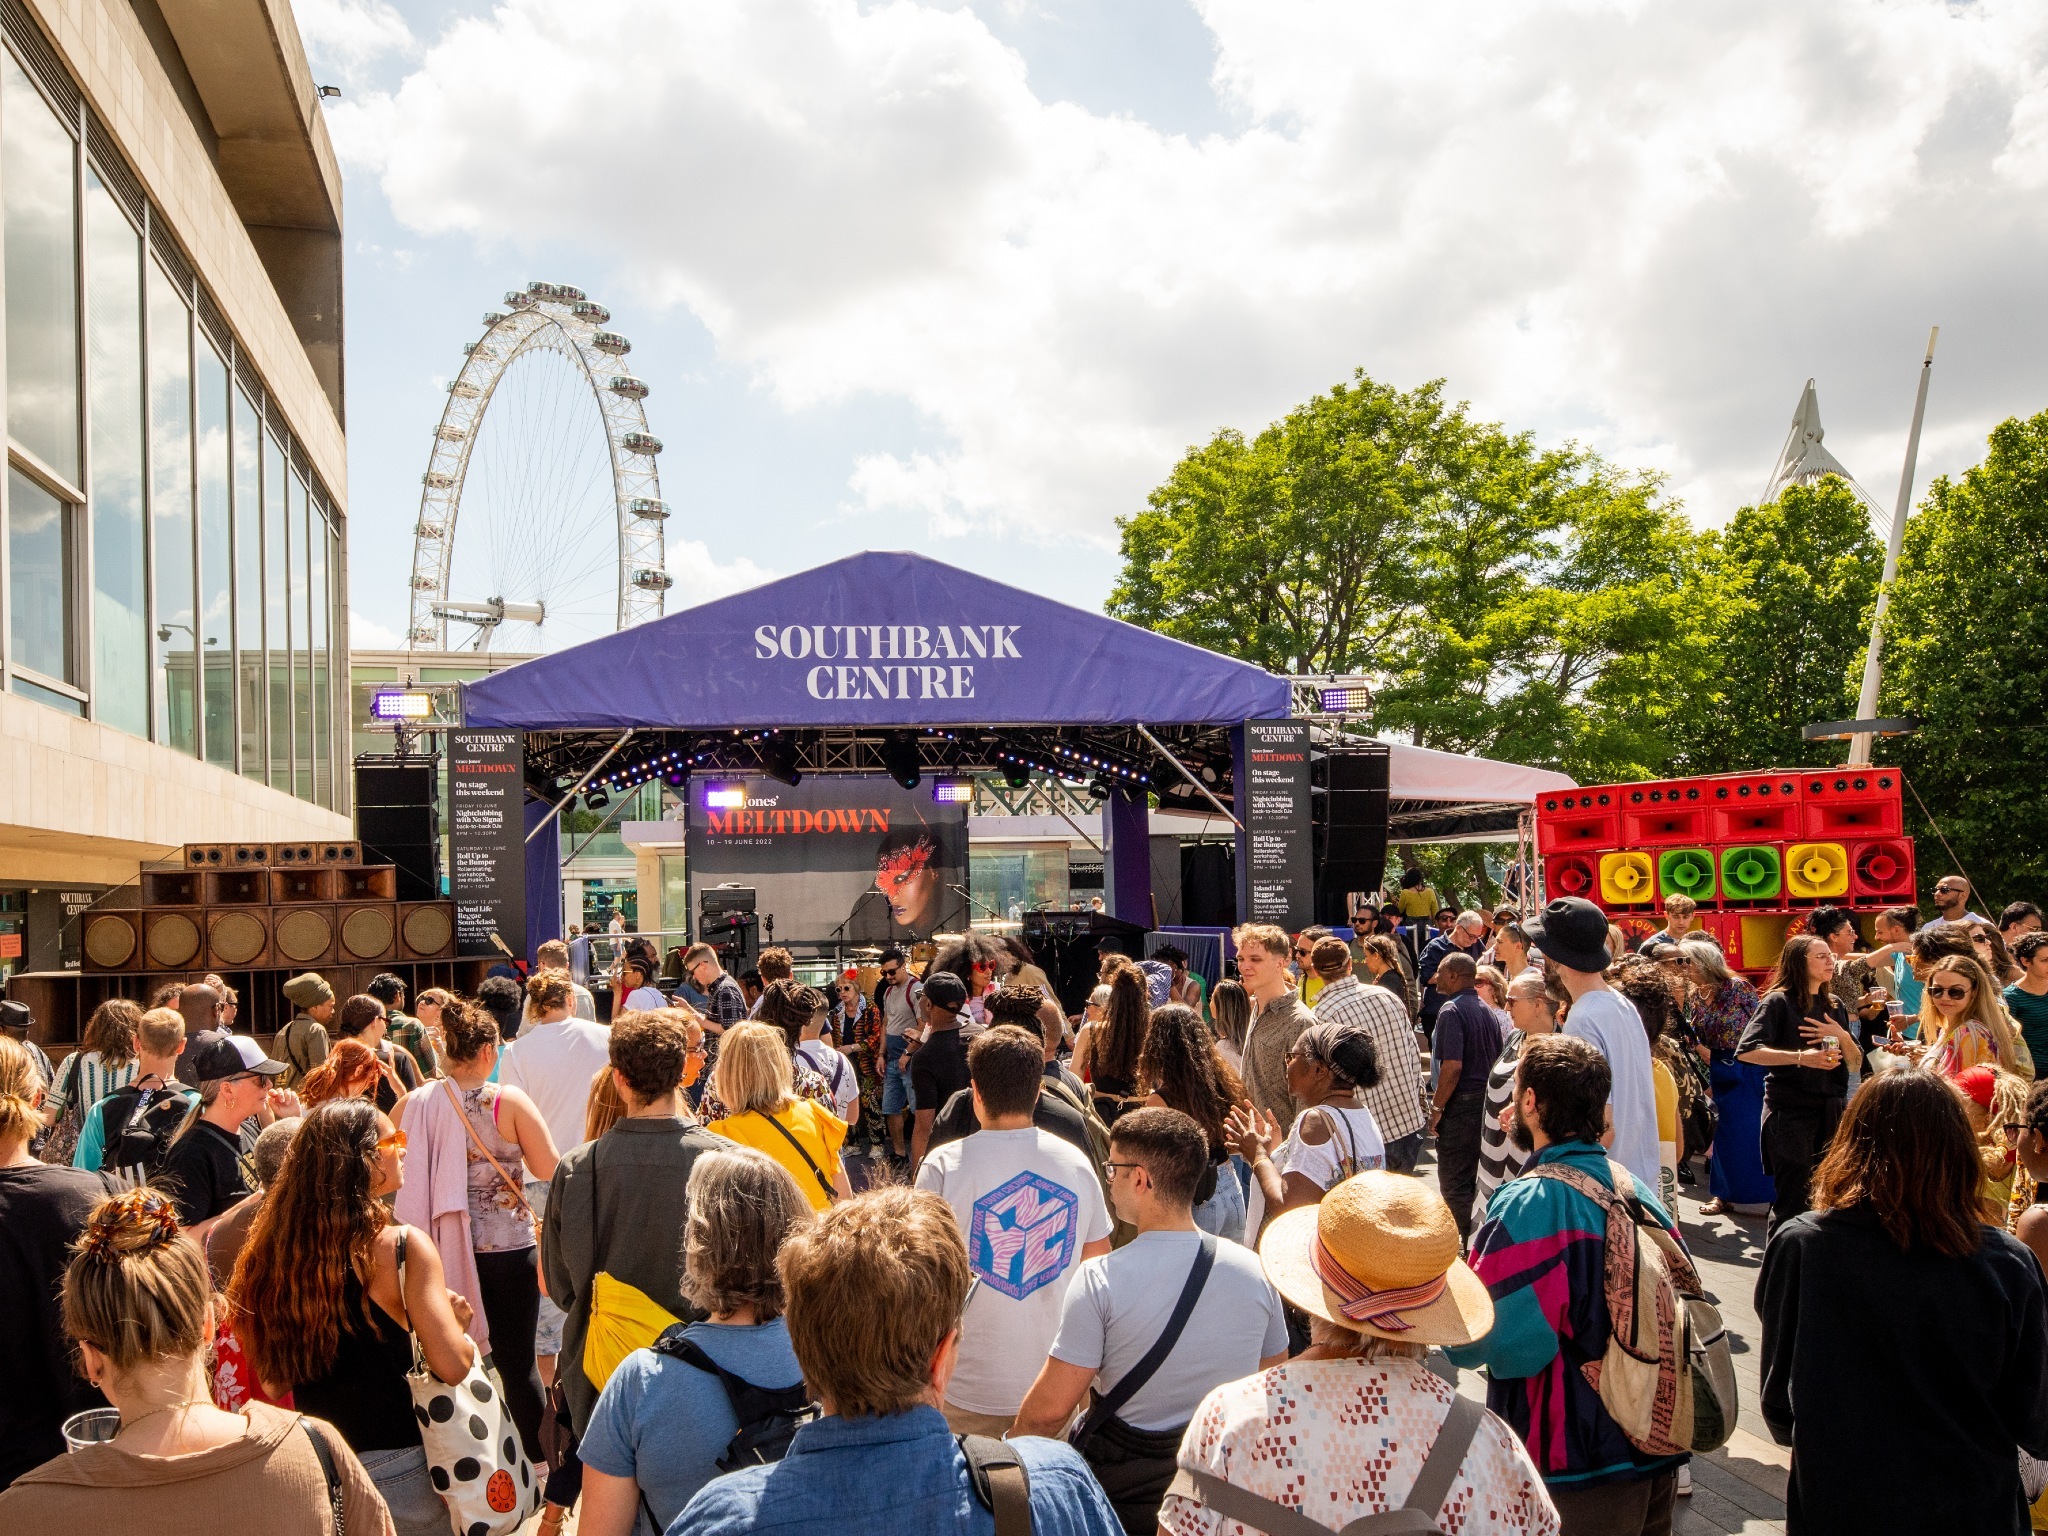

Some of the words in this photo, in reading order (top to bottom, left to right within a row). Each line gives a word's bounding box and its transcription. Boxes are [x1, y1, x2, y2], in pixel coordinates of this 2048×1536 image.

[754, 625, 1022, 659] SOUTHBANK
[806, 665, 974, 699] CENTRE
[454, 734, 516, 744] SOUTHBANK
[466, 744, 504, 752] CENTRE
[1252, 754, 1304, 762] MELTDOWN
[456, 764, 516, 772] MELTDOWN
[468, 782, 488, 790] stage
[706, 809, 891, 835] MELTDOWN
[60, 893, 92, 904] SOUTHBANK
[978, 1190, 1002, 1207] YOUTH
[1002, 1173, 1033, 1194] CULTURE
[1032, 1179, 1059, 1193] SINCE
[974, 1208, 984, 1236] YORK
[1061, 1203, 1077, 1266] MANHATTAN
[971, 1236, 980, 1262] NEW
[1021, 1277, 1037, 1296] EAST
